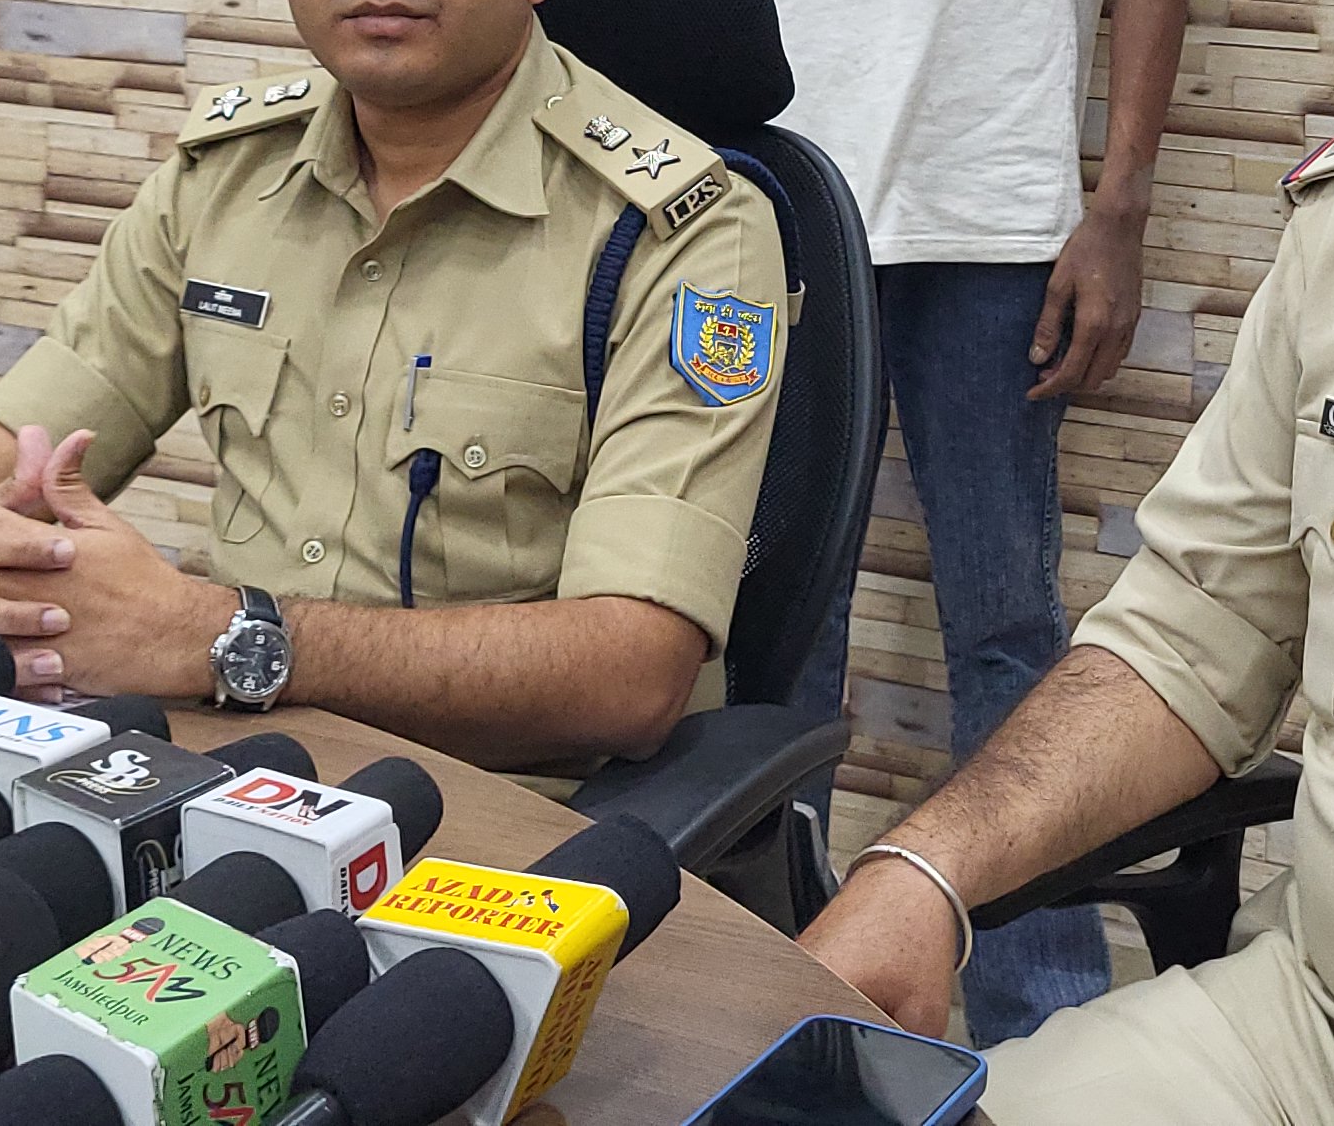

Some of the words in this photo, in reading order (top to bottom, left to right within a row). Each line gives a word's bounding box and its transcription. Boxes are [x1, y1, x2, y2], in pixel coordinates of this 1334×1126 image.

[211, 797, 260, 812] DAILY
[257, 808, 314, 827] NATION
[222, 777, 354, 822] DN
[410, 876, 514, 907] AZAD
[380, 892, 566, 938] REPORTER
[150, 933, 243, 982] NEWS
